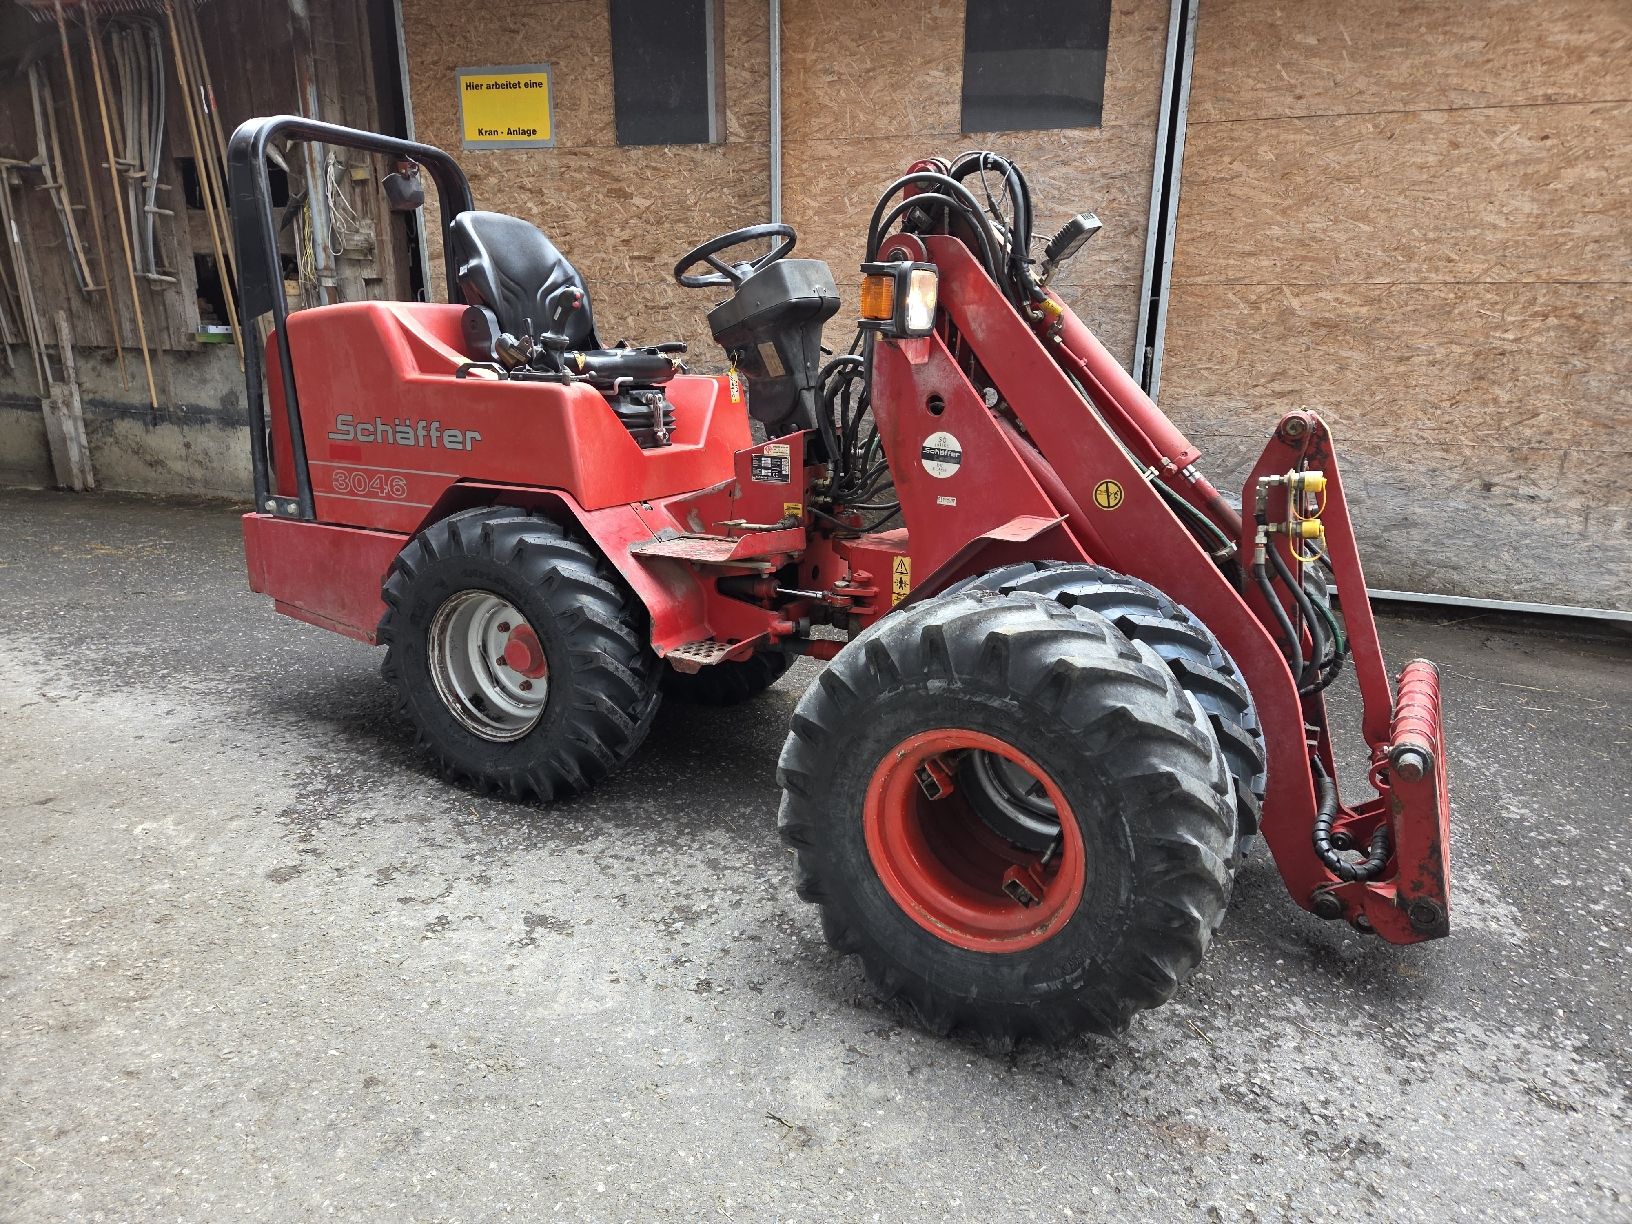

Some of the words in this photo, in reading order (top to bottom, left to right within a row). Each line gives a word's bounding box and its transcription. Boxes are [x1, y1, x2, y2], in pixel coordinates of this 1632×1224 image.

[465, 82, 484, 91] Hier
[485, 81, 522, 90] arbeitet
[524, 80, 544, 89] eine
[478, 128, 499, 136] Kran
[506, 127, 538, 137] Anlage
[328, 413, 482, 451] Schäffer
[333, 470, 408, 498] 3046
